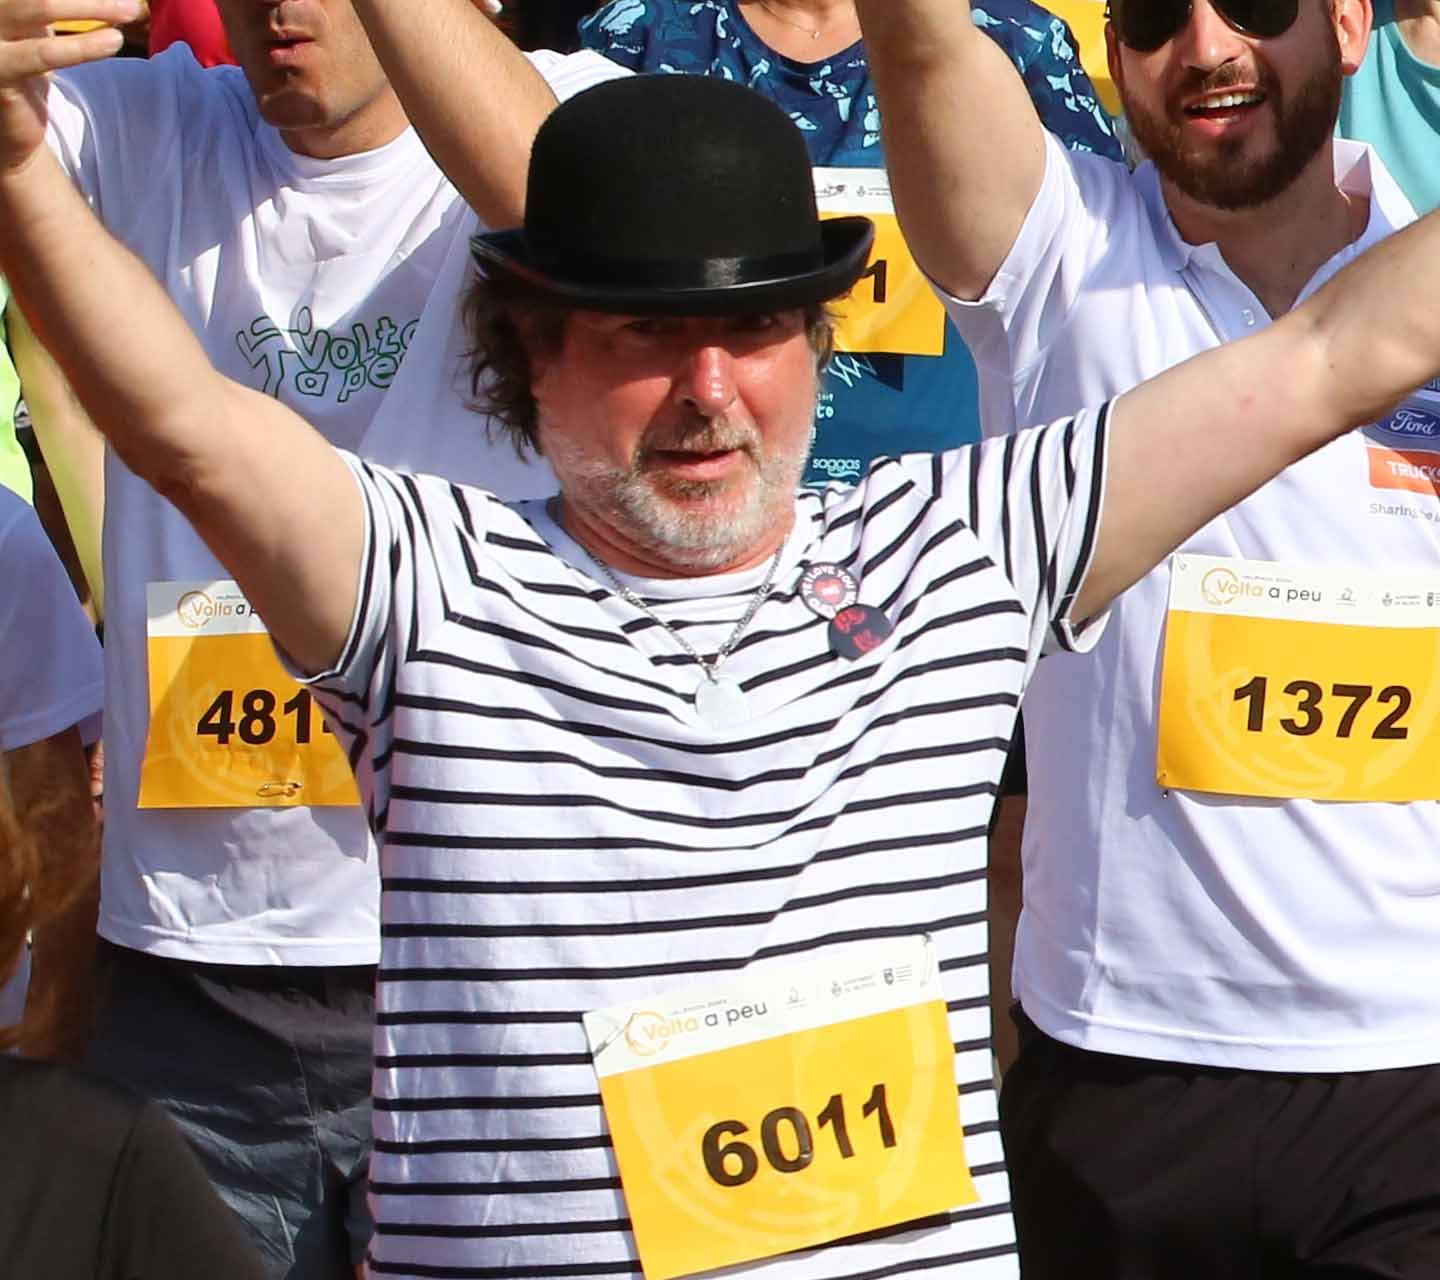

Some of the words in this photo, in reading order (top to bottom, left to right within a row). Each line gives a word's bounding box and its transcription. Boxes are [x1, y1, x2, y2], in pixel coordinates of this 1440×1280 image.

[1391, 410, 1435, 435] Ford
[812, 456, 861, 475] saggas
[1216, 578, 1264, 598] Volta
[1268, 587, 1281, 600] a
[1287, 586, 1323, 603] peu
[192, 604, 233, 618] Volta
[234, 603, 246, 616] a
[196, 689, 338, 745] 481
[1232, 676, 1413, 741] 1372
[643, 1016, 699, 1042] Volta
[704, 1009, 719, 1028] a
[725, 999, 769, 1029] peu
[700, 1080, 901, 1189] 6011
